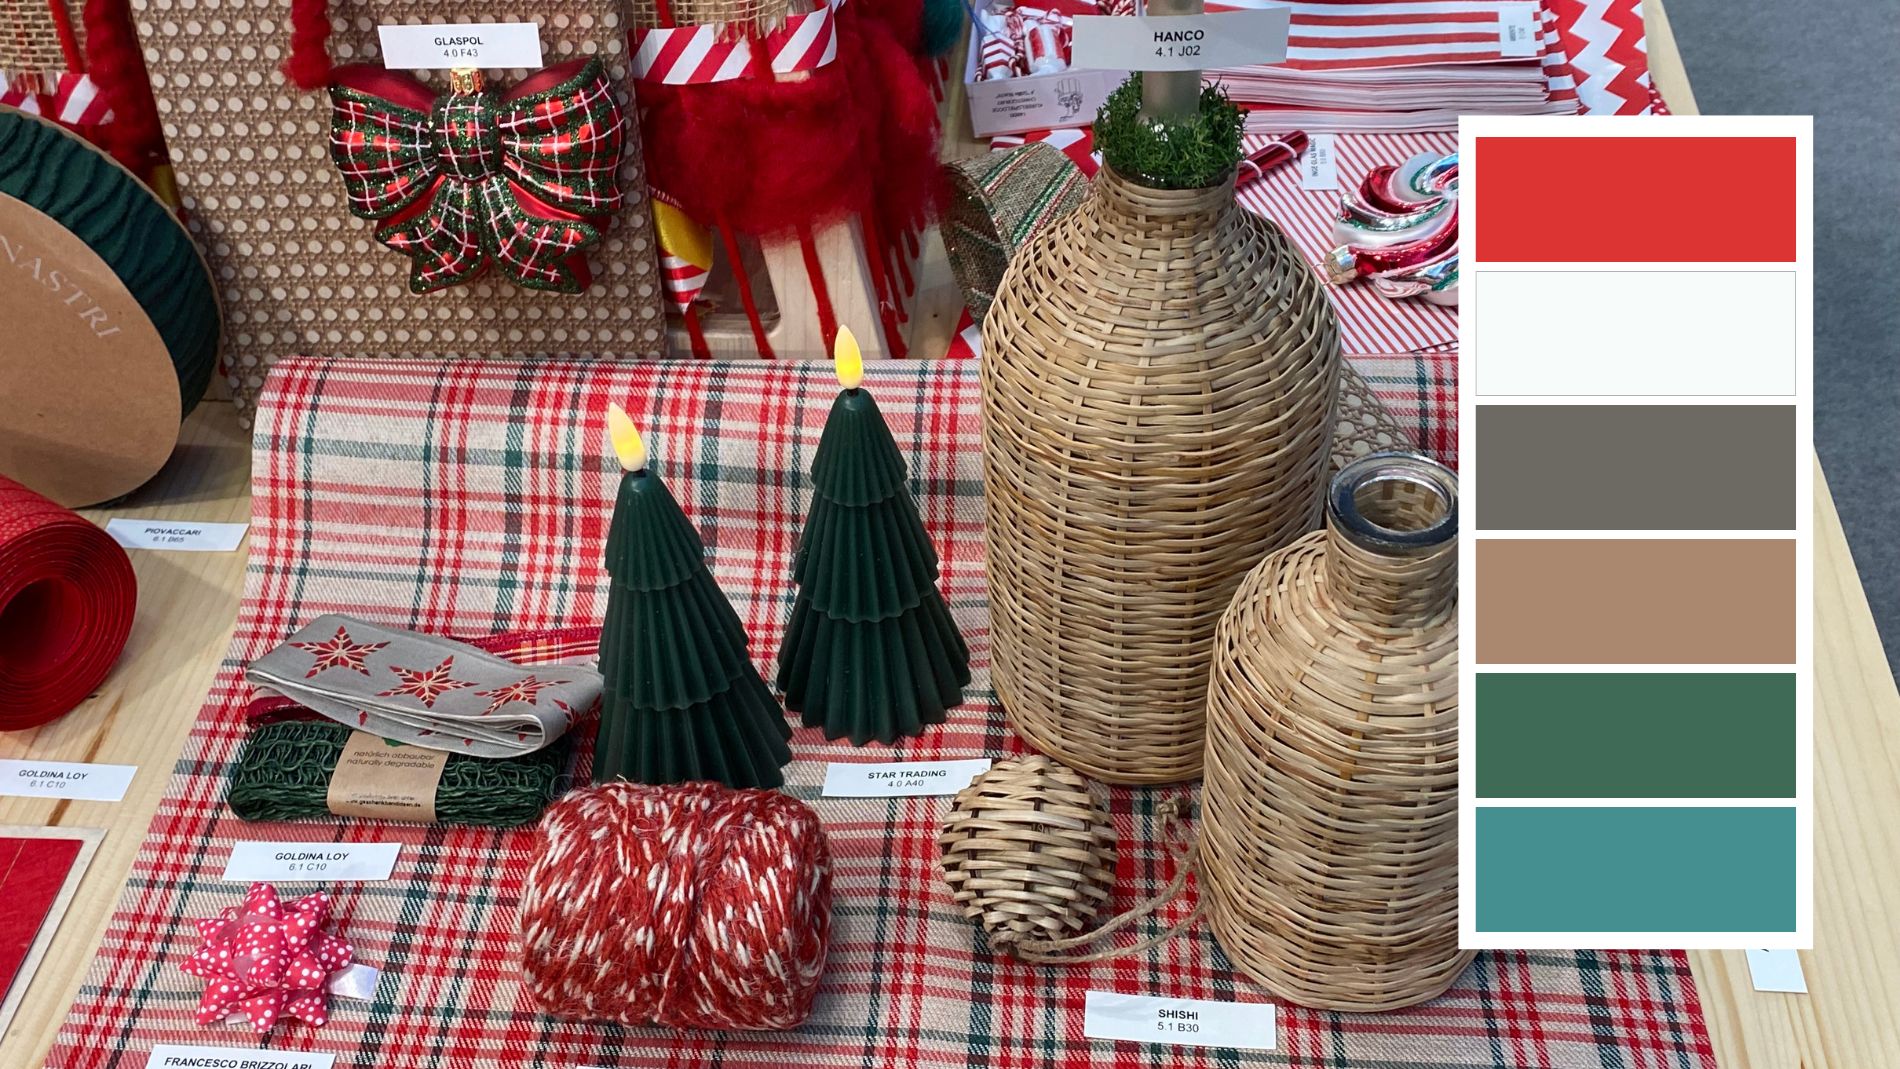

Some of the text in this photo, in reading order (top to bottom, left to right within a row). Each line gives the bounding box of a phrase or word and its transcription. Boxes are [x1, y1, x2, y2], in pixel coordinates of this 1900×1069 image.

[1153, 29, 1205, 43] HANCO
[434, 37, 484, 46] GLASPOL
[460, 49, 479, 57] F43
[1155, 45, 1201, 57] 4.1 J02
[144, 527, 202, 536] PIOVACCARI
[353, 750, 390, 759] natürlich
[346, 758, 435, 769] naturally degradable
[18, 769, 89, 780] GOLDINA LOY
[900, 770, 947, 778] TRADING
[46, 780, 67, 789] C10
[904, 780, 925, 788] A40
[275, 852, 350, 861] GOLDINA LOY
[306, 863, 327, 871] C10
[1158, 1009, 1199, 1021] SHISHI
[1157, 1022, 1200, 1033] 5.1 B30
[164, 1056, 239, 1069] FRANCESCO
